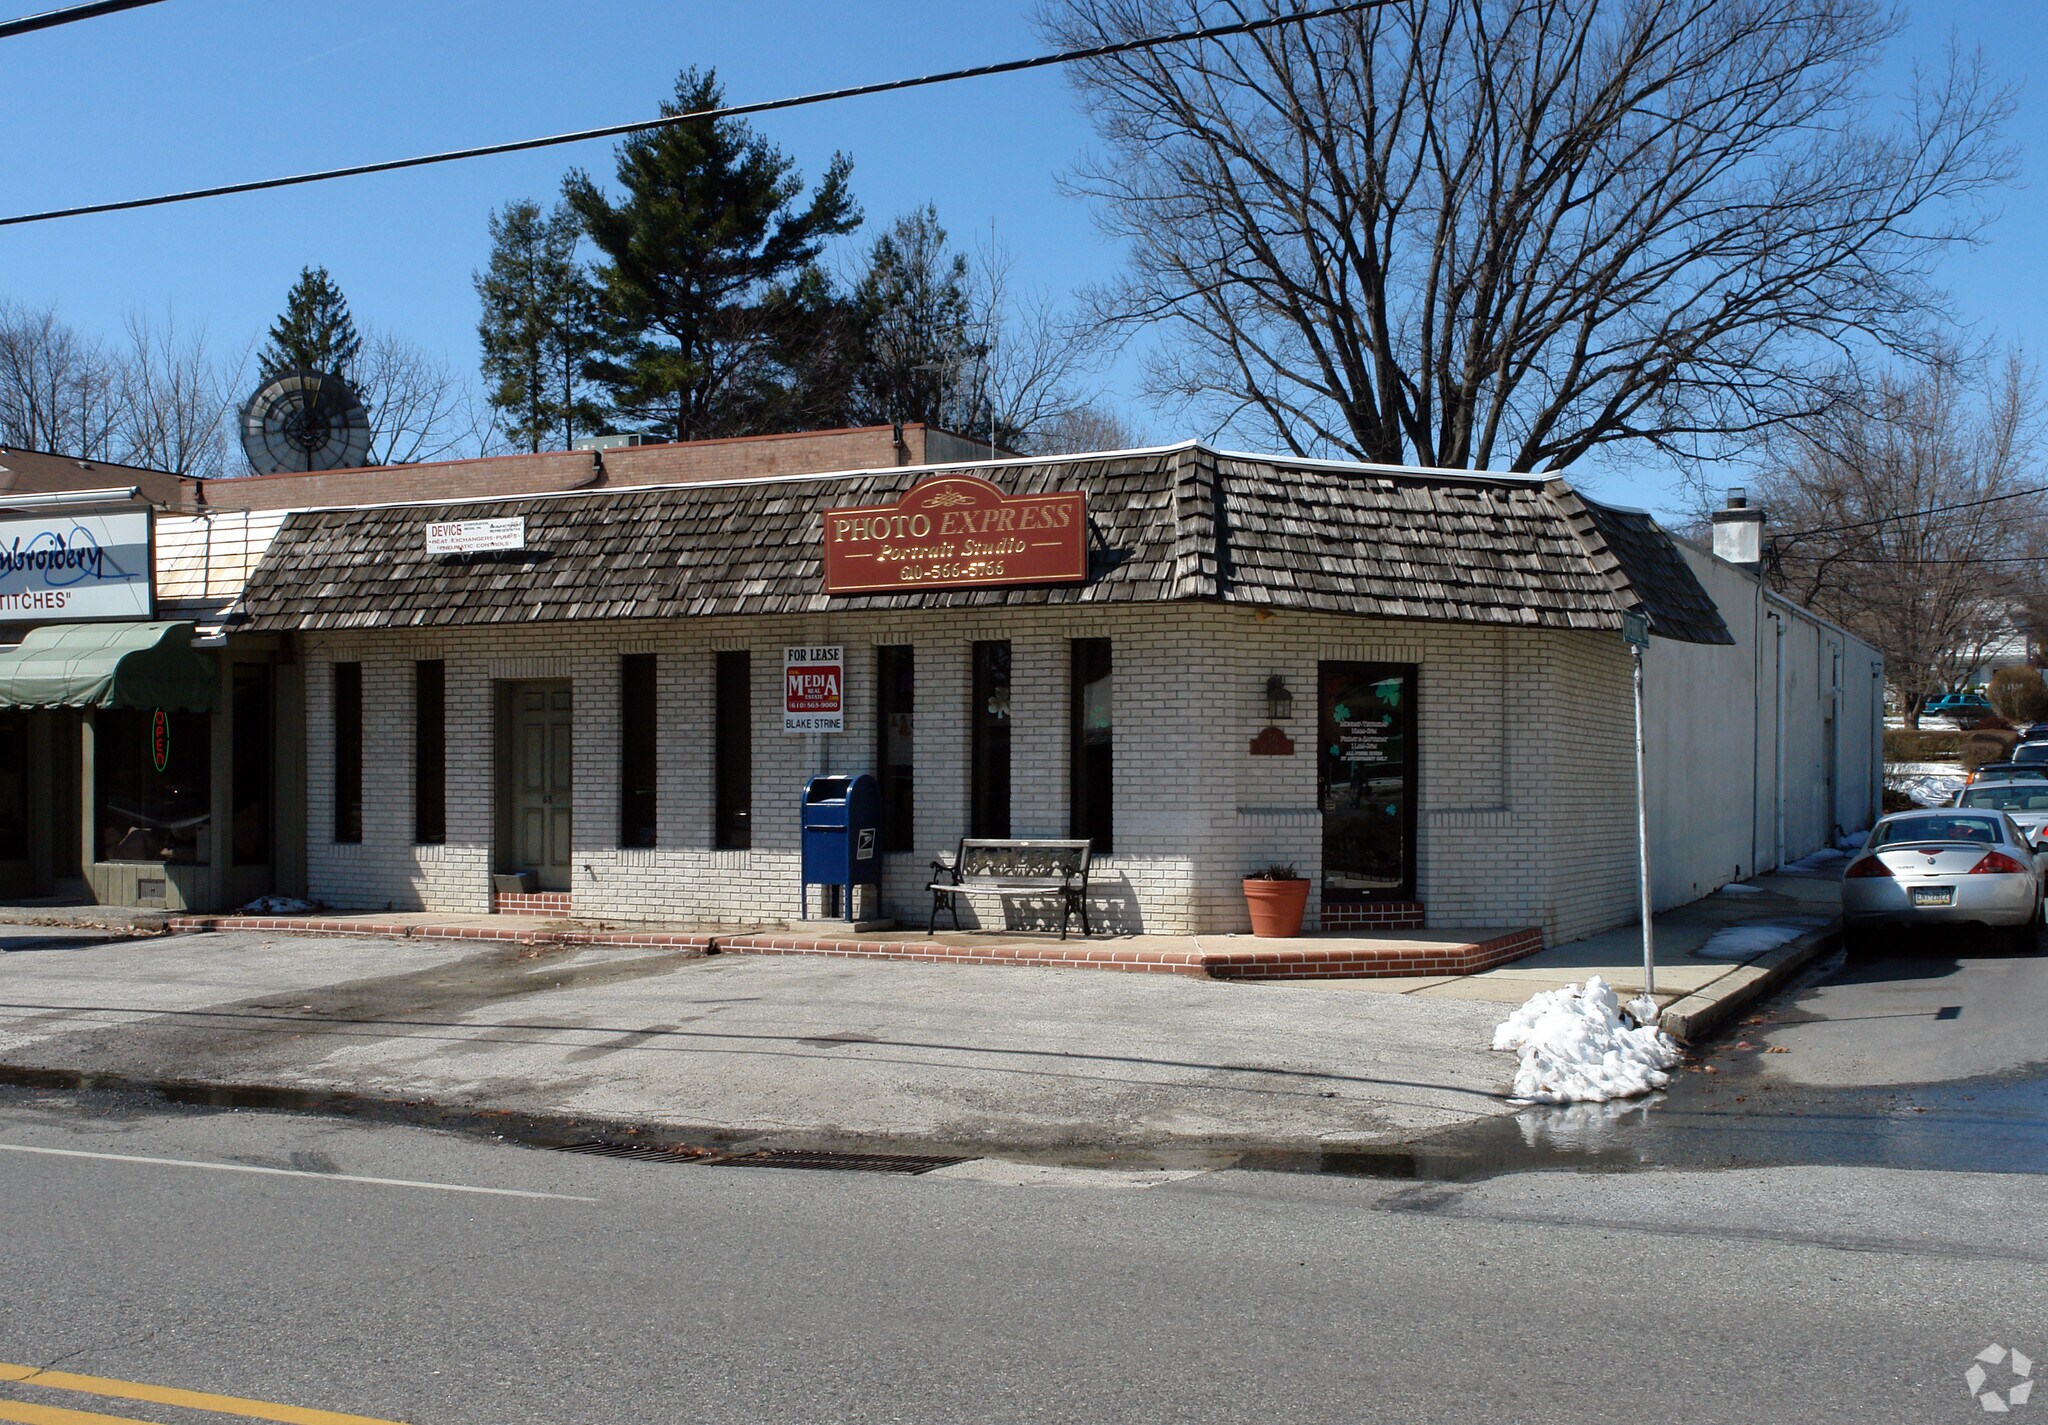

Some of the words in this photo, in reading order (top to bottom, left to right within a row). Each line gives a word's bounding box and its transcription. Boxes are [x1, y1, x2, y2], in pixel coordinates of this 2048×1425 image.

[431, 524, 462, 537] DEVICE
[834, 514, 931, 543] PHOTO
[938, 503, 1073, 536] EXPRESS
[877, 542, 955, 561] Portrait
[961, 538, 1026, 557] Studio
[901, 560, 1004, 580] 610-566-5766
[788, 649, 807, 661] FOR
[810, 648, 840, 661] LEASE
[788, 674, 839, 696] MEDIA
[786, 719, 811, 729] BLAKE
[814, 718, 841, 729] STRINE
